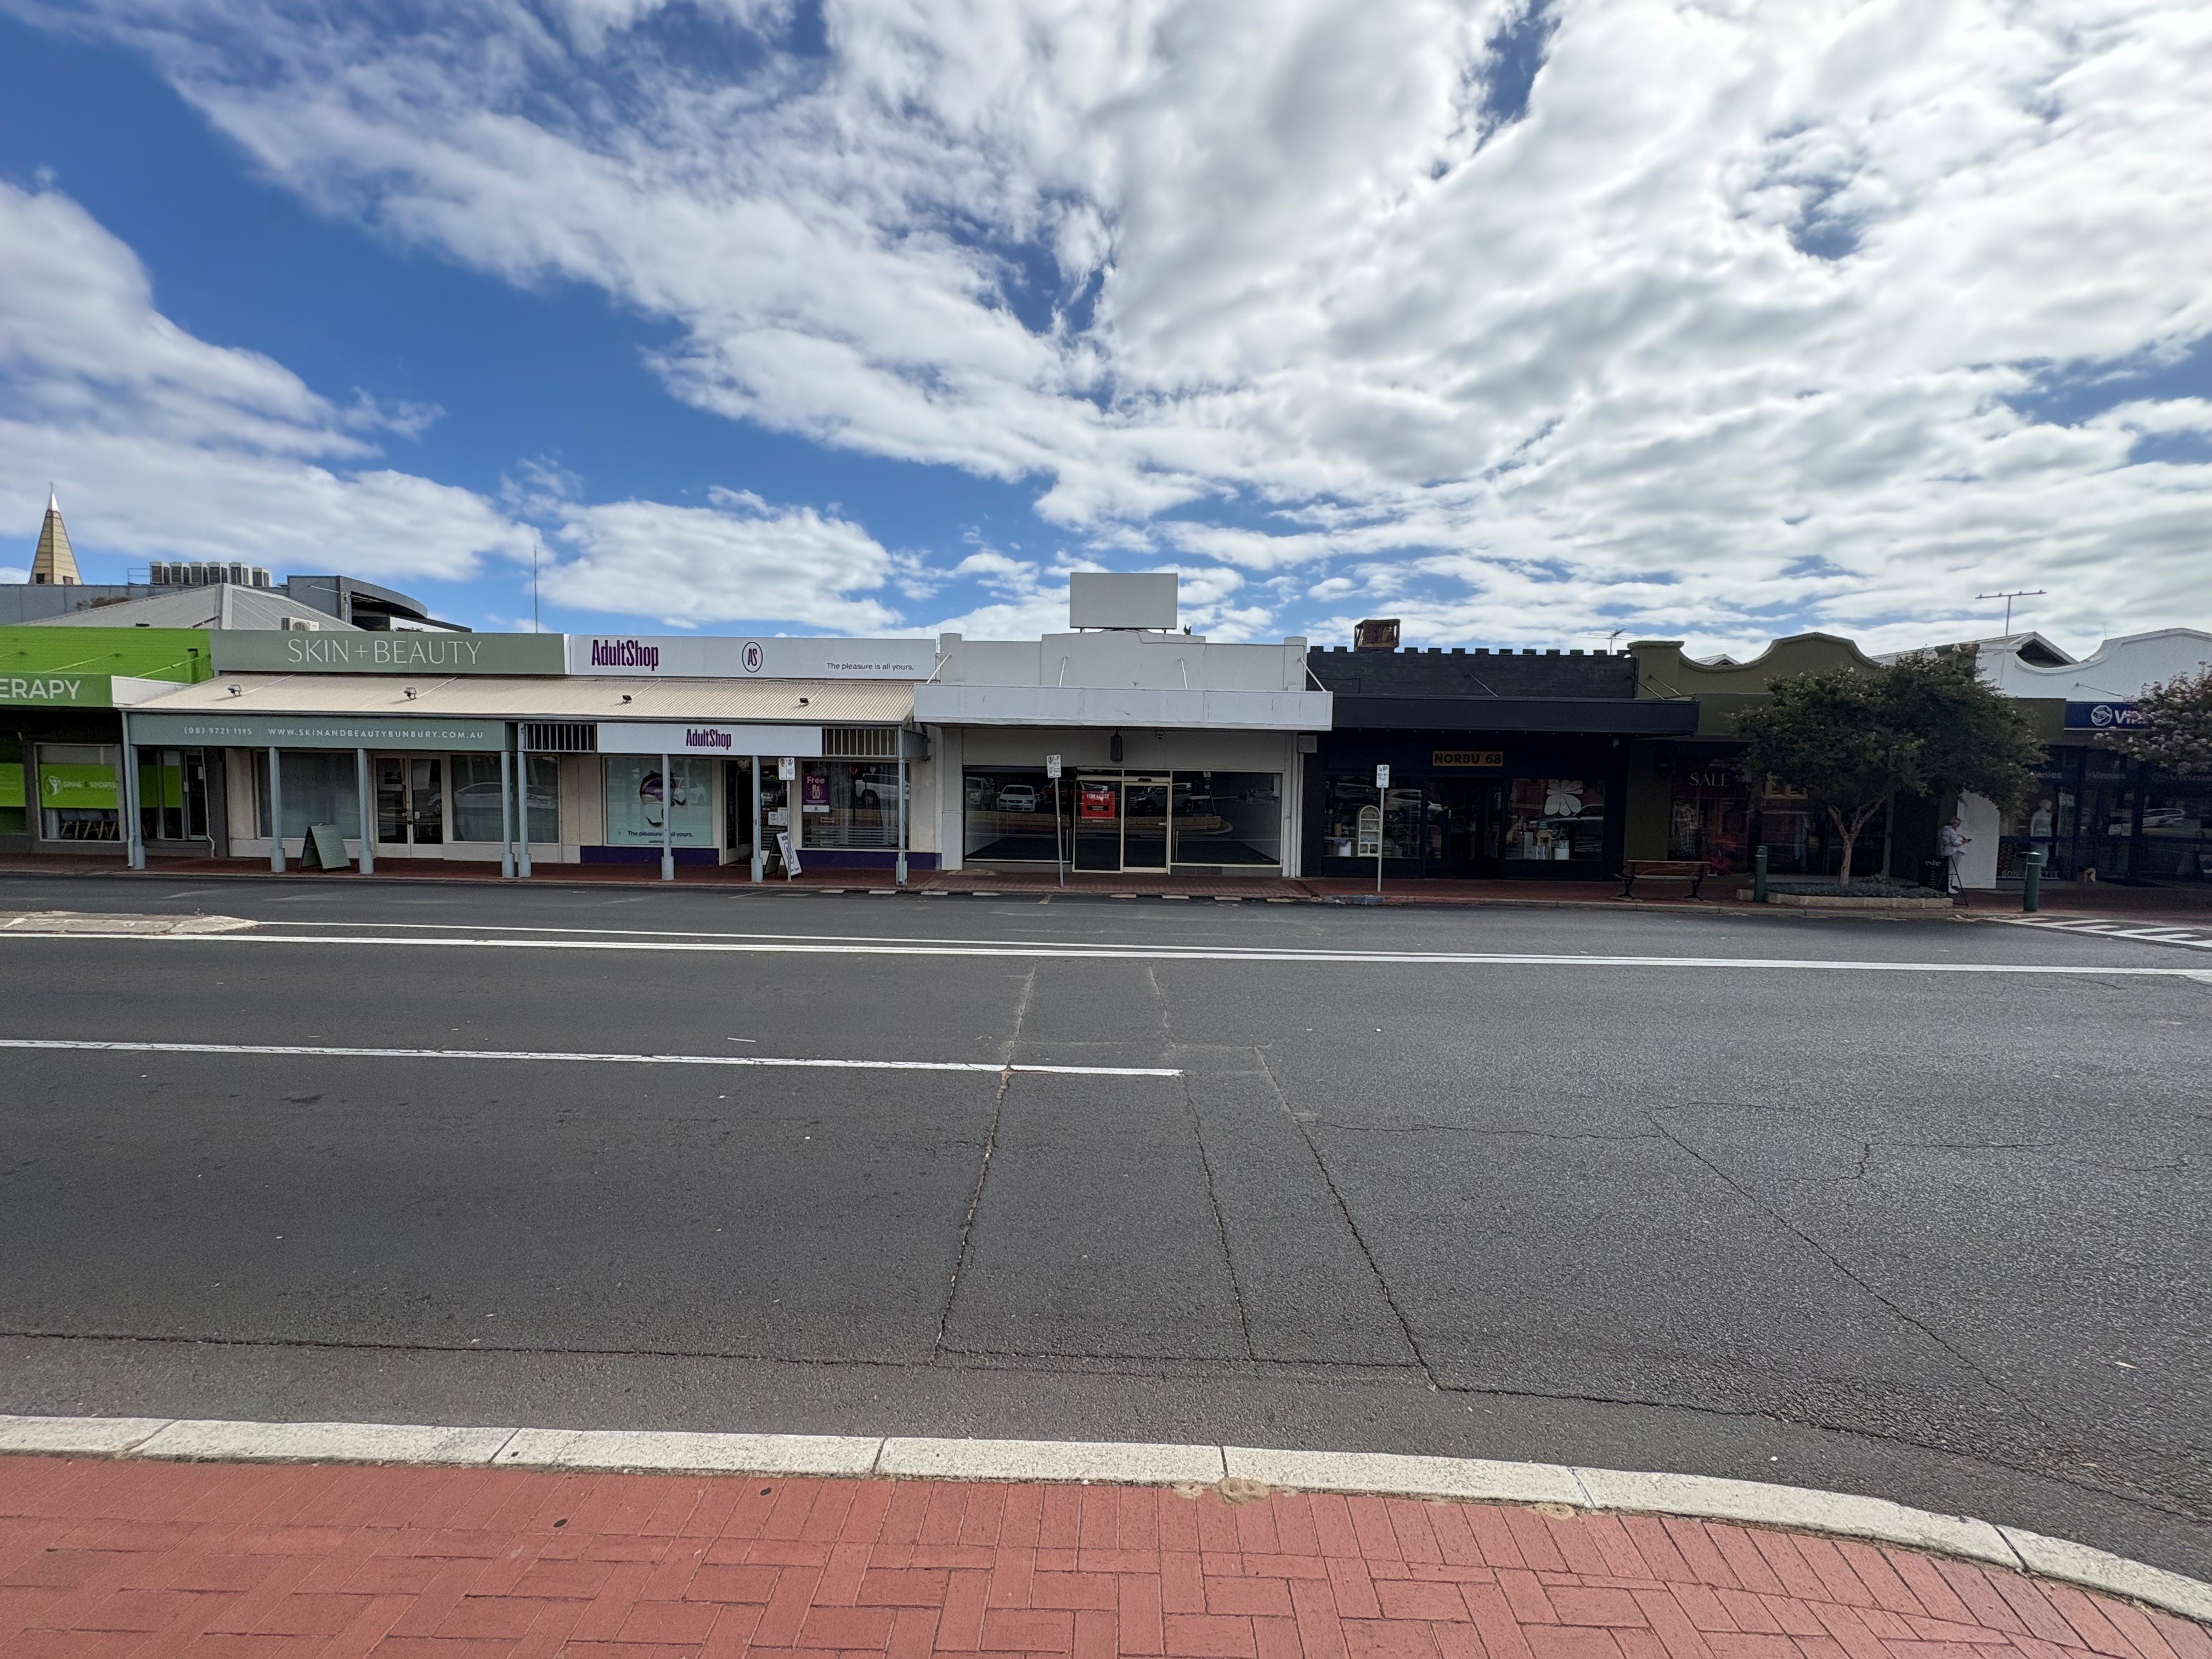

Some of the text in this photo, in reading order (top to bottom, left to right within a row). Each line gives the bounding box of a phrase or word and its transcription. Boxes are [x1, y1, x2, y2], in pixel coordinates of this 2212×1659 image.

[287, 639, 349, 663] SKIN
[374, 640, 482, 664] BEAUTY
[591, 639, 659, 672] AdultShop
[747, 648, 758, 666] AS
[268, 728, 483, 739] WWW.SKINANDBEAUTYBUNBURY.COM.AU
[685, 728, 732, 751] AdultShop
[1434, 753, 1502, 764] NORBU 68
[806, 776, 826, 784] Free
[1689, 772, 1730, 787] SALE
